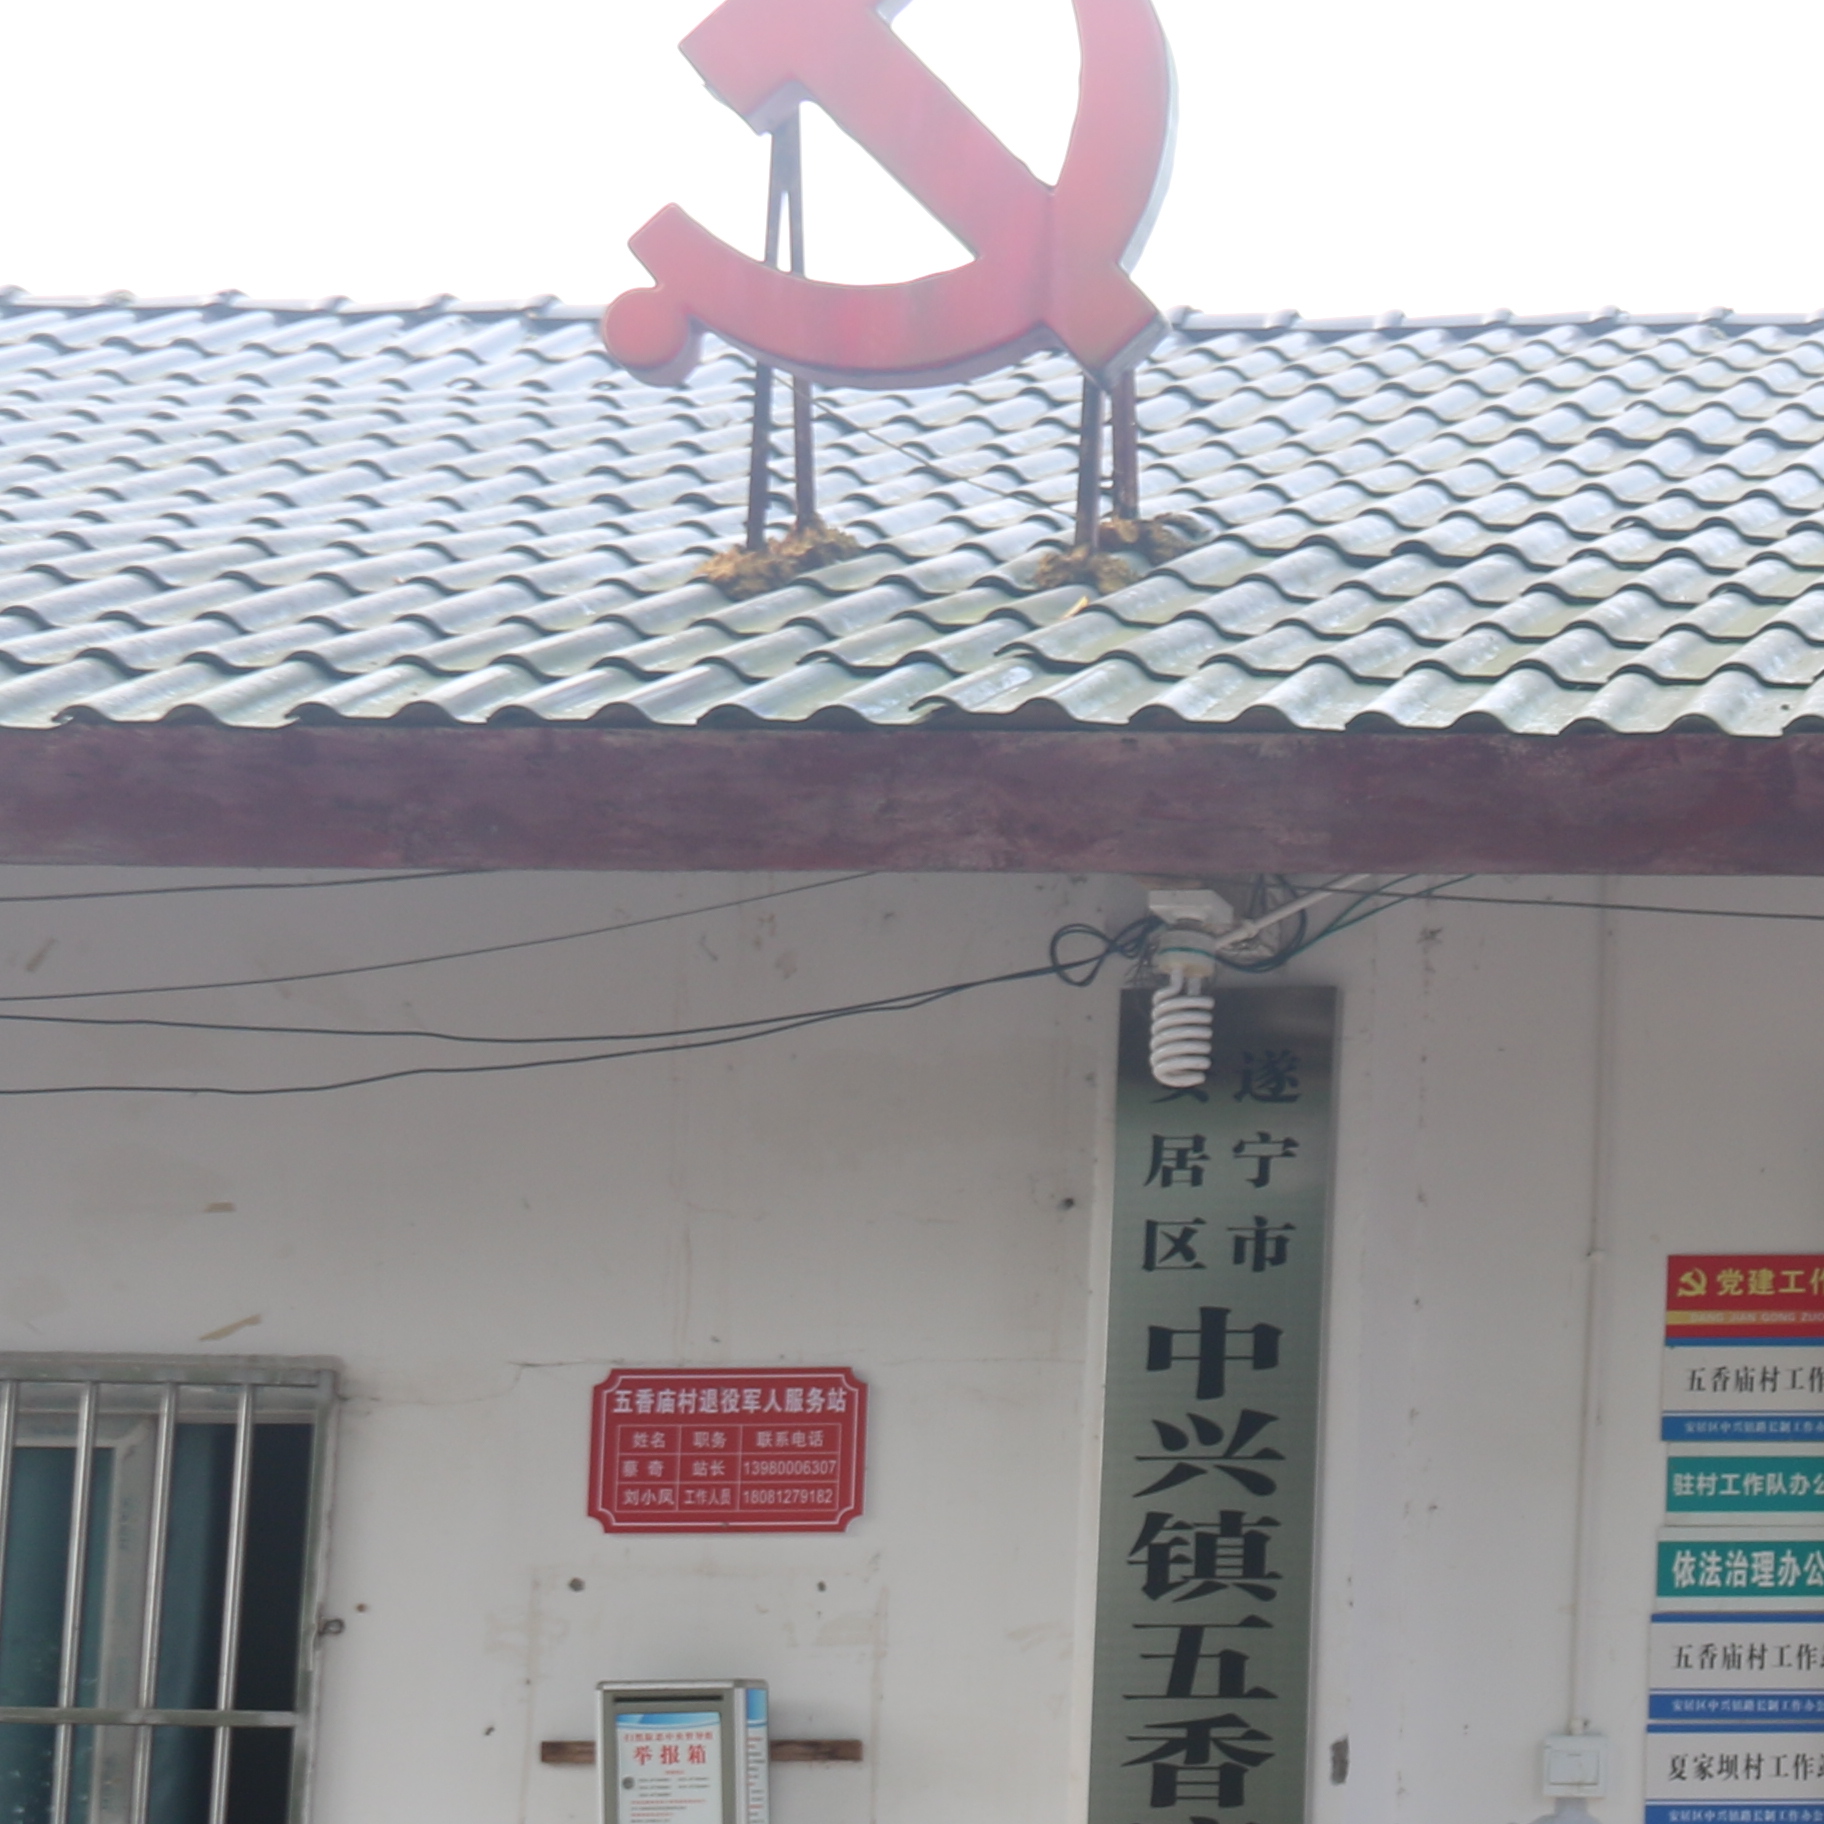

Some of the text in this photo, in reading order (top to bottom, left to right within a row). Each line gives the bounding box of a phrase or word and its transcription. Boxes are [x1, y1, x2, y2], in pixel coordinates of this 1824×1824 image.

[1226, 1050, 1302, 1273] 遂宁市
[1142, 1084, 1212, 1273] 居区
[1729, 1312, 1757, 1322] JIAN
[1761, 1312, 1796, 1322] GONG
[612, 1386, 847, 1414] 五香庙村退役军人服务站
[632, 1431, 666, 1449] 姓名
[692, 1431, 727, 1449] 职务
[756, 1430, 825, 1448] 联系电话
[691, 1459, 726, 1476] 站长
[743, 1459, 838, 1475] 13980006307
[684, 1488, 731, 1505] 工作人员
[742, 1488, 834, 1505] 18081279182
[633, 1744, 707, 1766] 举报箱
